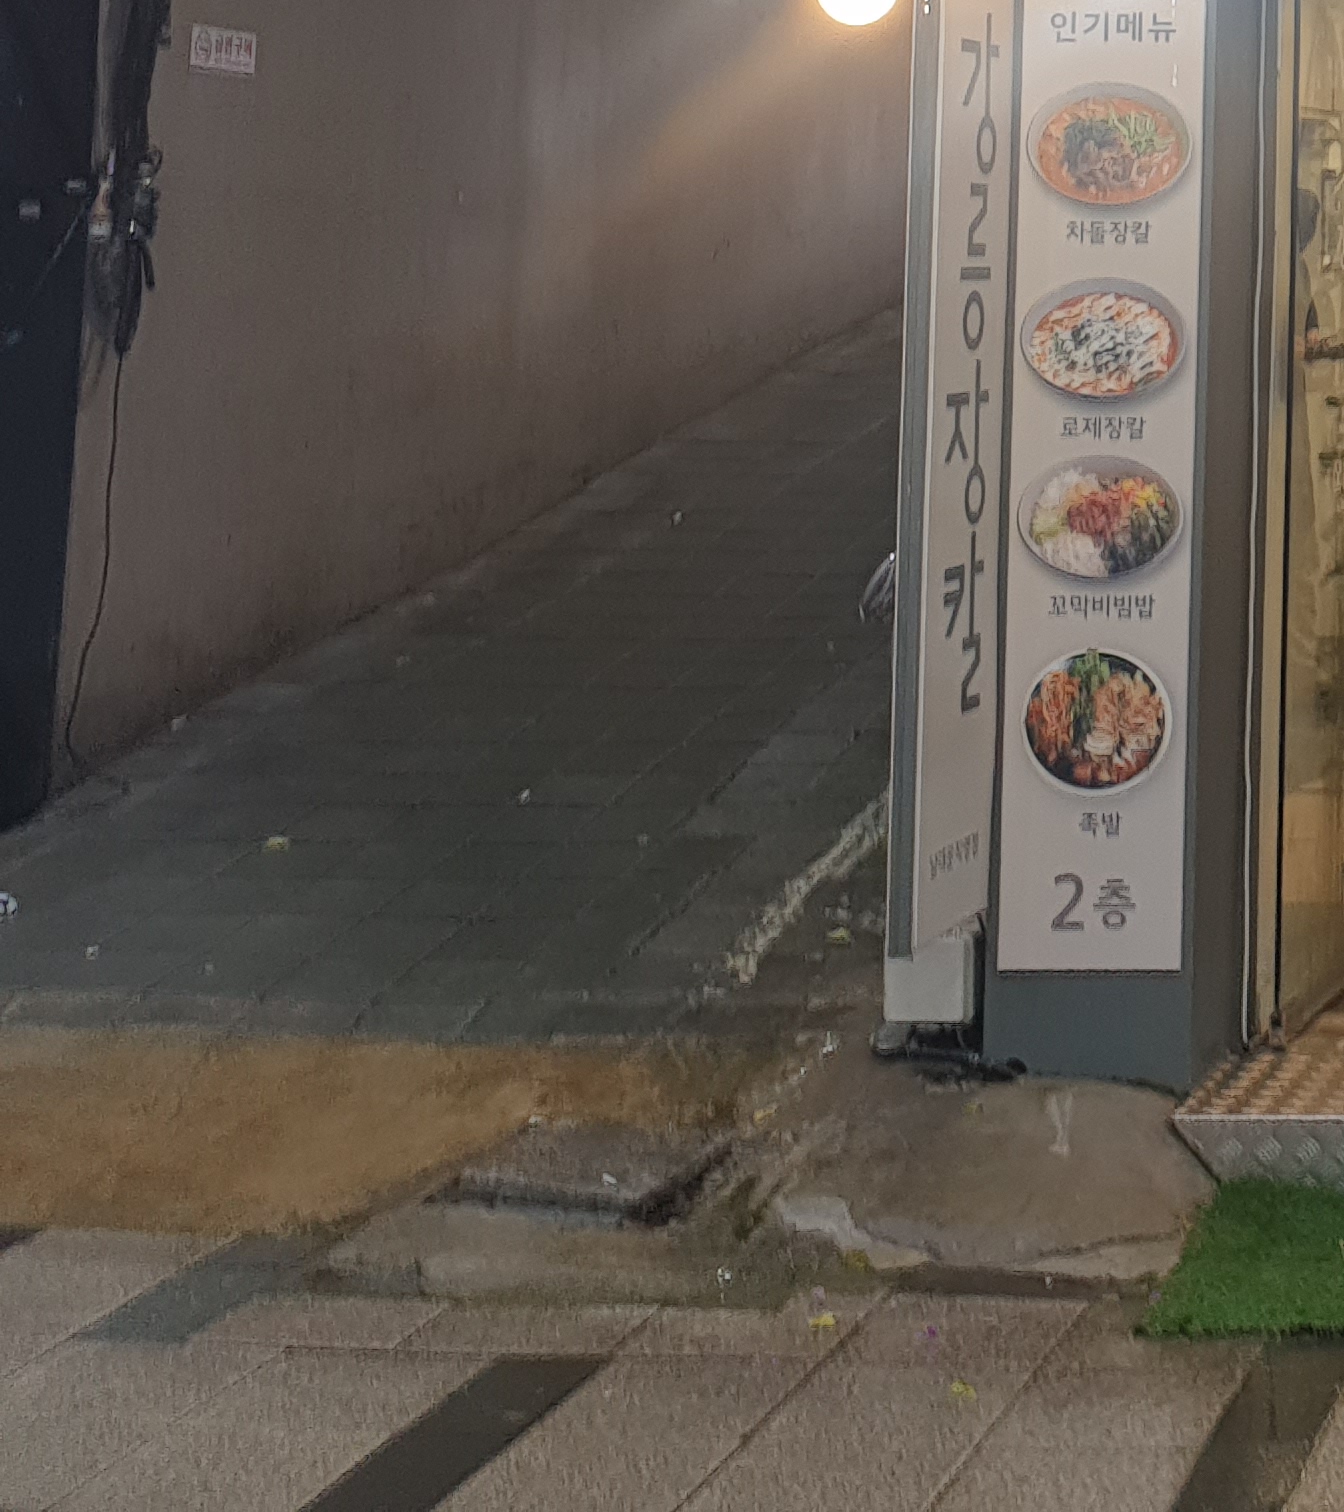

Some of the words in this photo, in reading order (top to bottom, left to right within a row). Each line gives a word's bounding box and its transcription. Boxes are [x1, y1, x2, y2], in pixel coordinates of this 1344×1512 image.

[1050, 10, 1178, 45] 인기메뉴
[943, 12, 1001, 716] 강릉장칼
[1050, 871, 1138, 932] 2층
